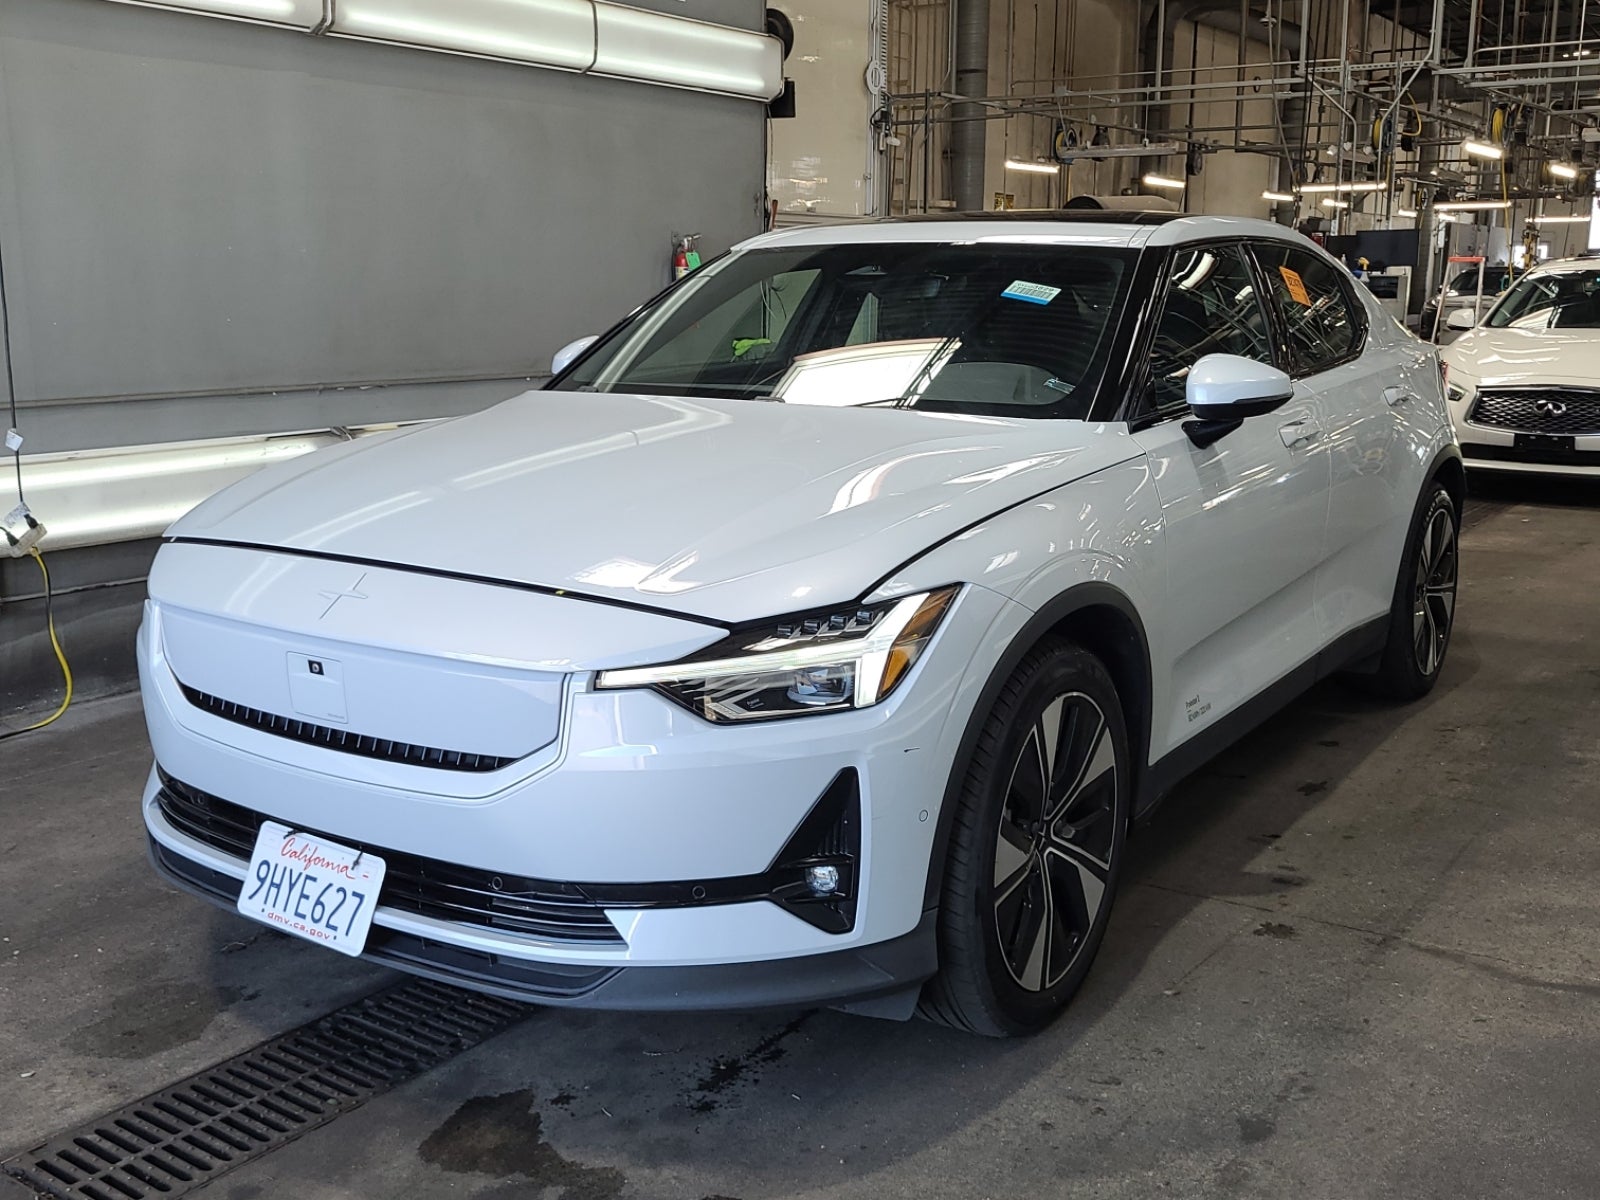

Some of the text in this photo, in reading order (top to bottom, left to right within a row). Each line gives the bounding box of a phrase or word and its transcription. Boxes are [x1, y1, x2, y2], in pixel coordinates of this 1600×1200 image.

[280, 837, 356, 879] California
[248, 859, 365, 937] 9HYE627
[267, 911, 330, 940] dmv.ca.gov
